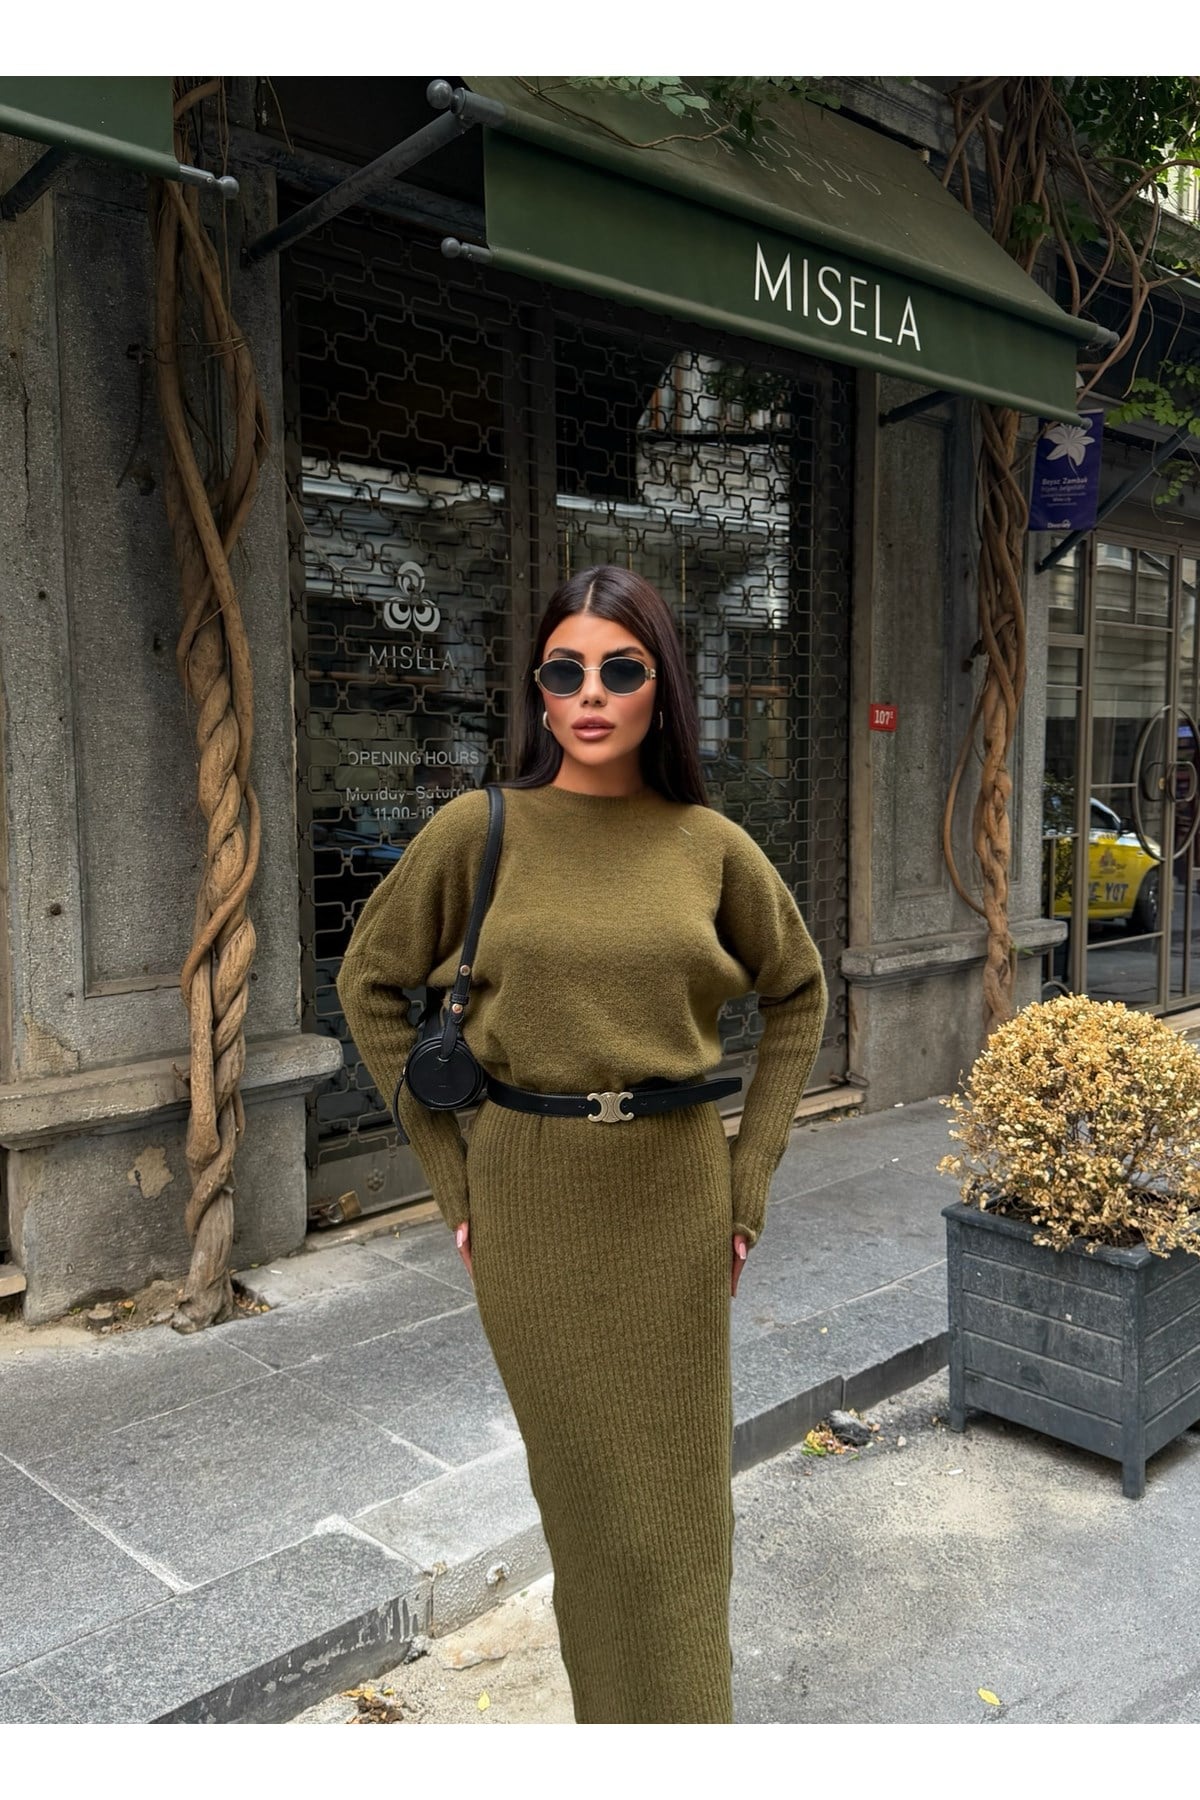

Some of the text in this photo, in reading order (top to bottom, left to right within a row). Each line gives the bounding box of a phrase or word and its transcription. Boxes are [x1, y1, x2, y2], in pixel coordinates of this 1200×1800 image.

[754, 241, 921, 352] MISELA
[369, 645, 456, 671] MISELA
[347, 751, 480, 766] OPENING HOURS
